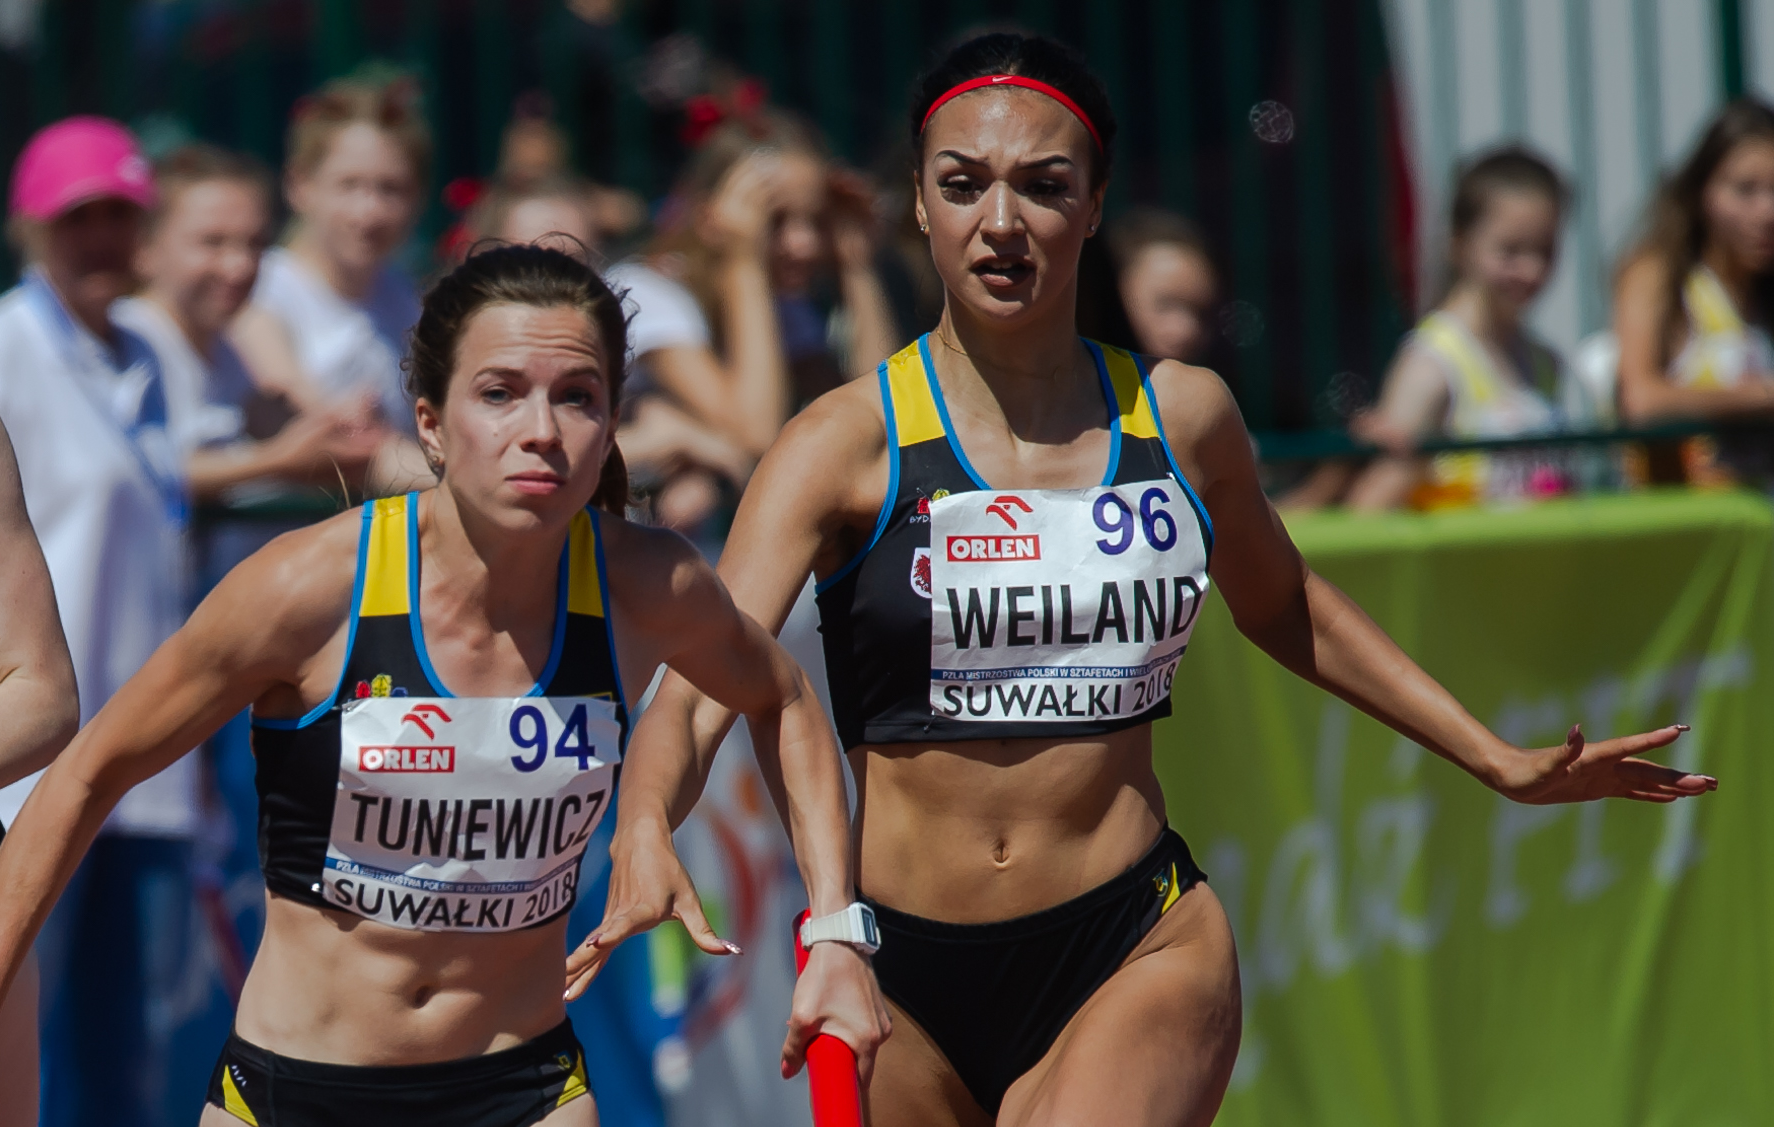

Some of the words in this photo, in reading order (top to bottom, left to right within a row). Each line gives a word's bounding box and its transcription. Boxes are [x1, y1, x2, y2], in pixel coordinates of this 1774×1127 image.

[950, 537, 1035, 559] ORLEN
[1092, 487, 1178, 555] 96
[946, 575, 1204, 650] WEILAND
[942, 671, 965, 680] PZLA
[966, 669, 1026, 681] MISTRZOSTWA
[1027, 667, 1059, 679] POLSKI
[1060, 667, 1069, 678] W
[1070, 667, 1124, 679] SZTAFETACH
[944, 684, 1122, 717] SUWAŁKI
[1132, 661, 1177, 712] 2018
[361, 749, 450, 771] ORLEN
[509, 704, 595, 773] 94
[351, 788, 607, 861] TUNIEWICZ
[336, 861, 359, 875] PZLA
[334, 878, 515, 928] SUWAŁKI
[522, 871, 575, 923] 2018
